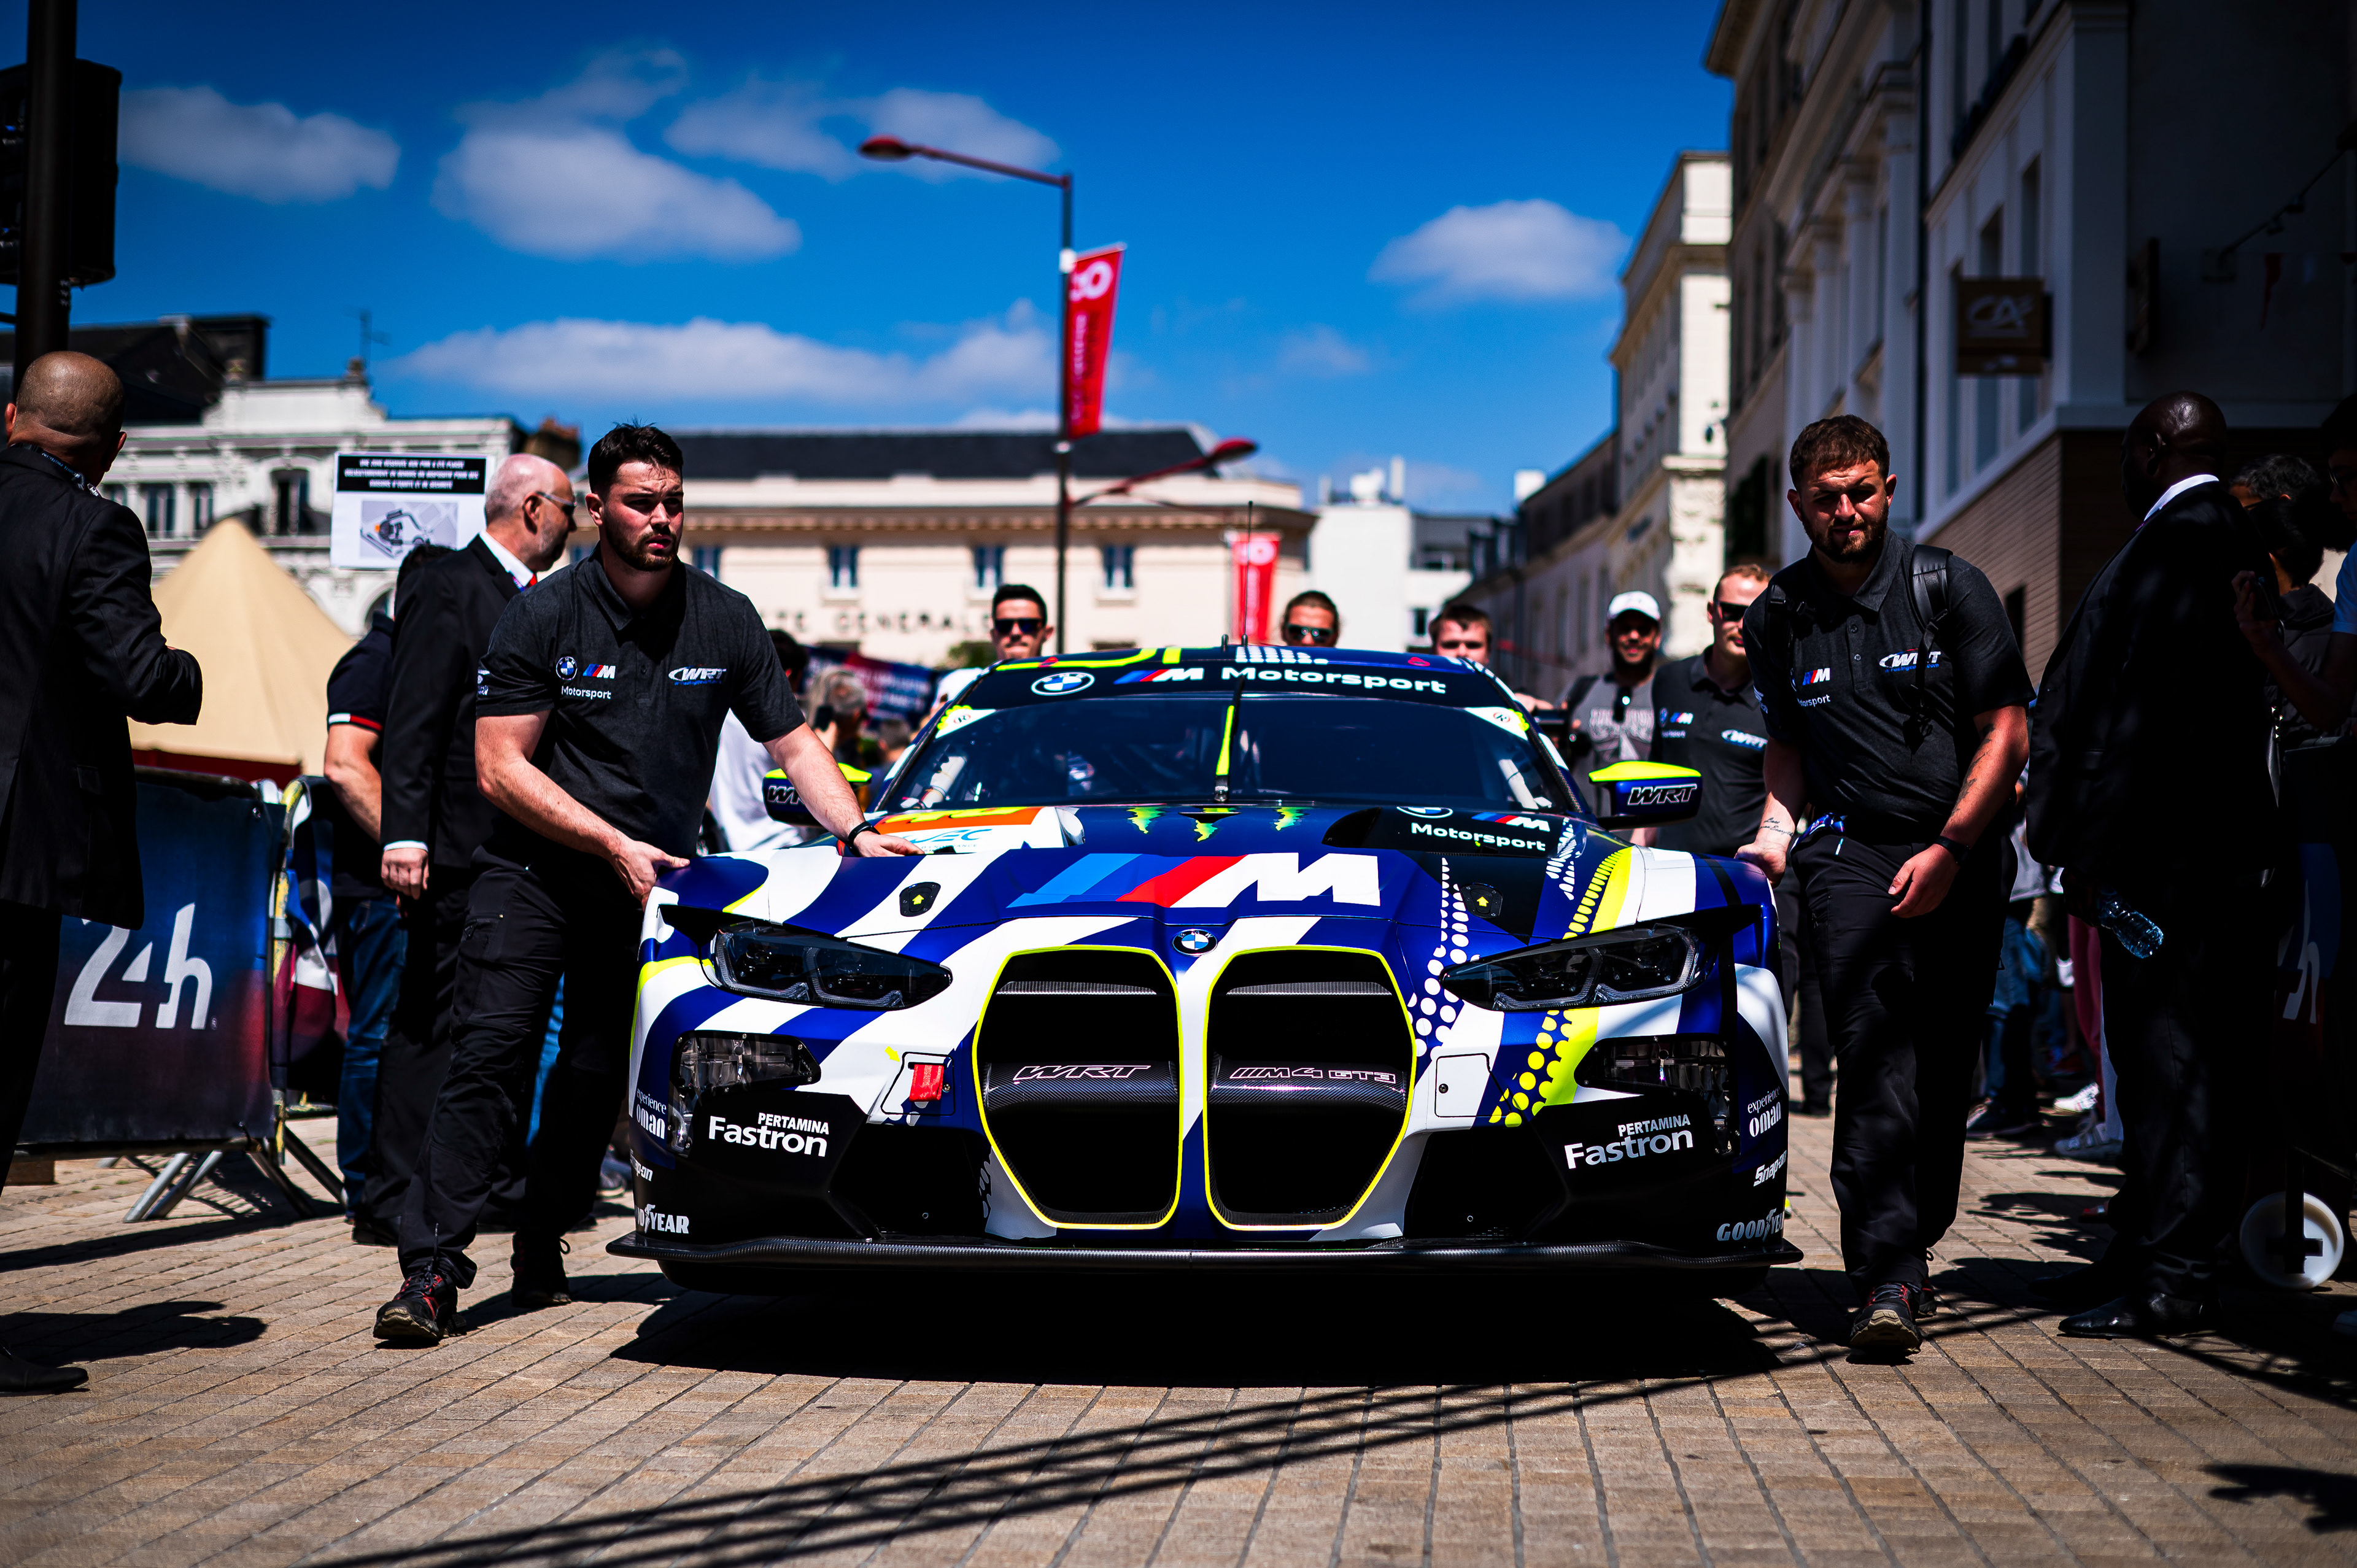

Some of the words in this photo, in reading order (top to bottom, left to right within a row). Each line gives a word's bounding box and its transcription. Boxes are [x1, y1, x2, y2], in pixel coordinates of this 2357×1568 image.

[677, 668, 727, 681] WRT
[1221, 667, 1447, 695] Motorsport
[561, 686, 611, 700] Motorsport
[1627, 783, 1697, 806] WRT
[1411, 822, 1546, 852] Motorsport
[1013, 1065, 1151, 1081] WRT
[1328, 1070, 1396, 1084] GT3
[1747, 1086, 1780, 1114] experience
[636, 1103, 665, 1140] oman
[757, 1112, 829, 1135] PERTAMINA
[1618, 1114, 1691, 1137] PERTAMINA
[1749, 1101, 1781, 1137] oman
[708, 1116, 827, 1157] Fastron
[1564, 1130, 1693, 1169] Fastron
[1753, 1149, 1787, 1187] Snap-on
